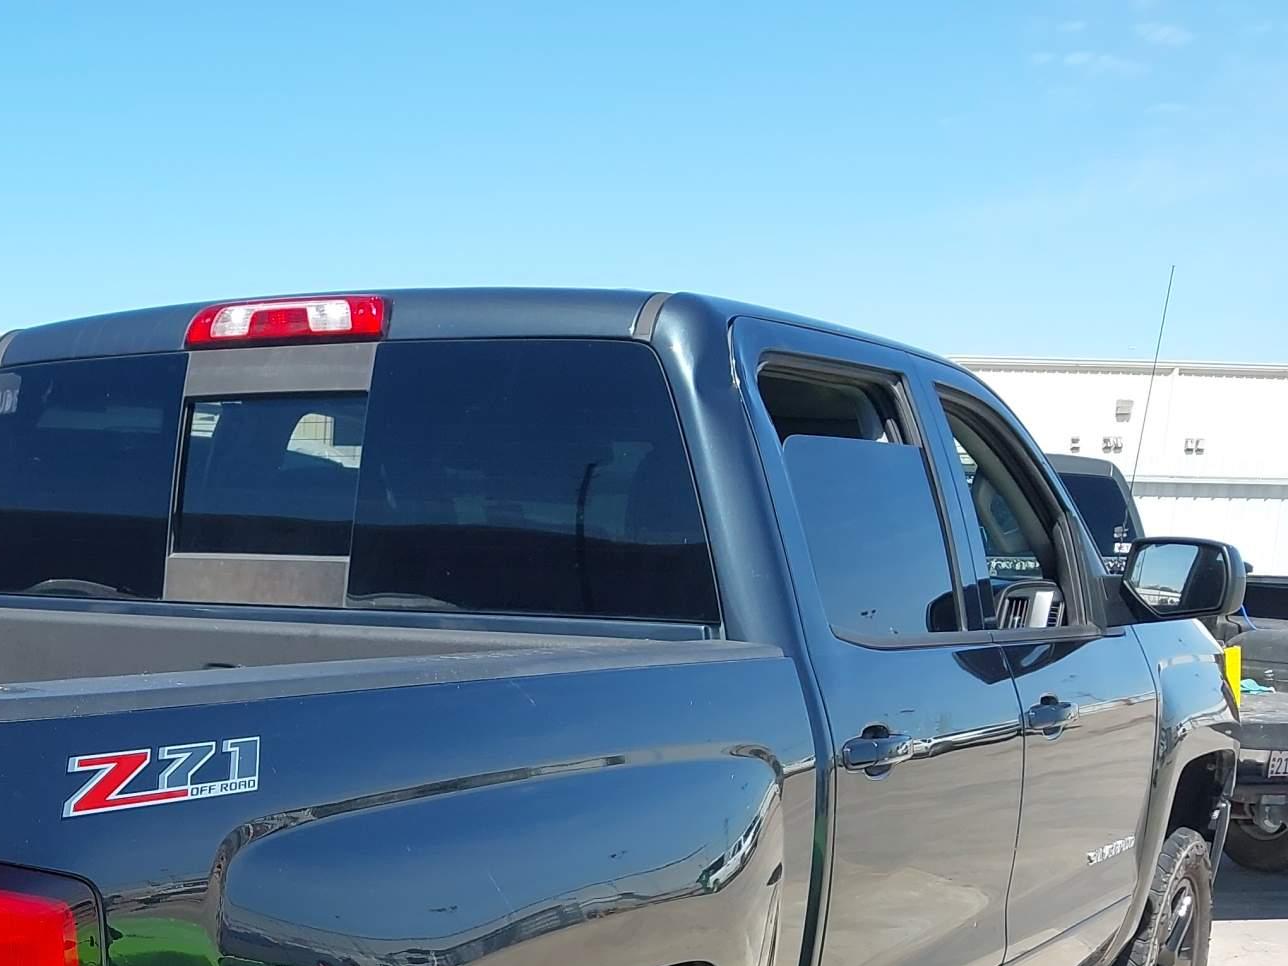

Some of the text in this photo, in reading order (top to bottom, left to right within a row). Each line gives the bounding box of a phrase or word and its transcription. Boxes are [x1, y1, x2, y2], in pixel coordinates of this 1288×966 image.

[63, 736, 260, 817] Z71
[190, 778, 257, 797] OFF ROAD
